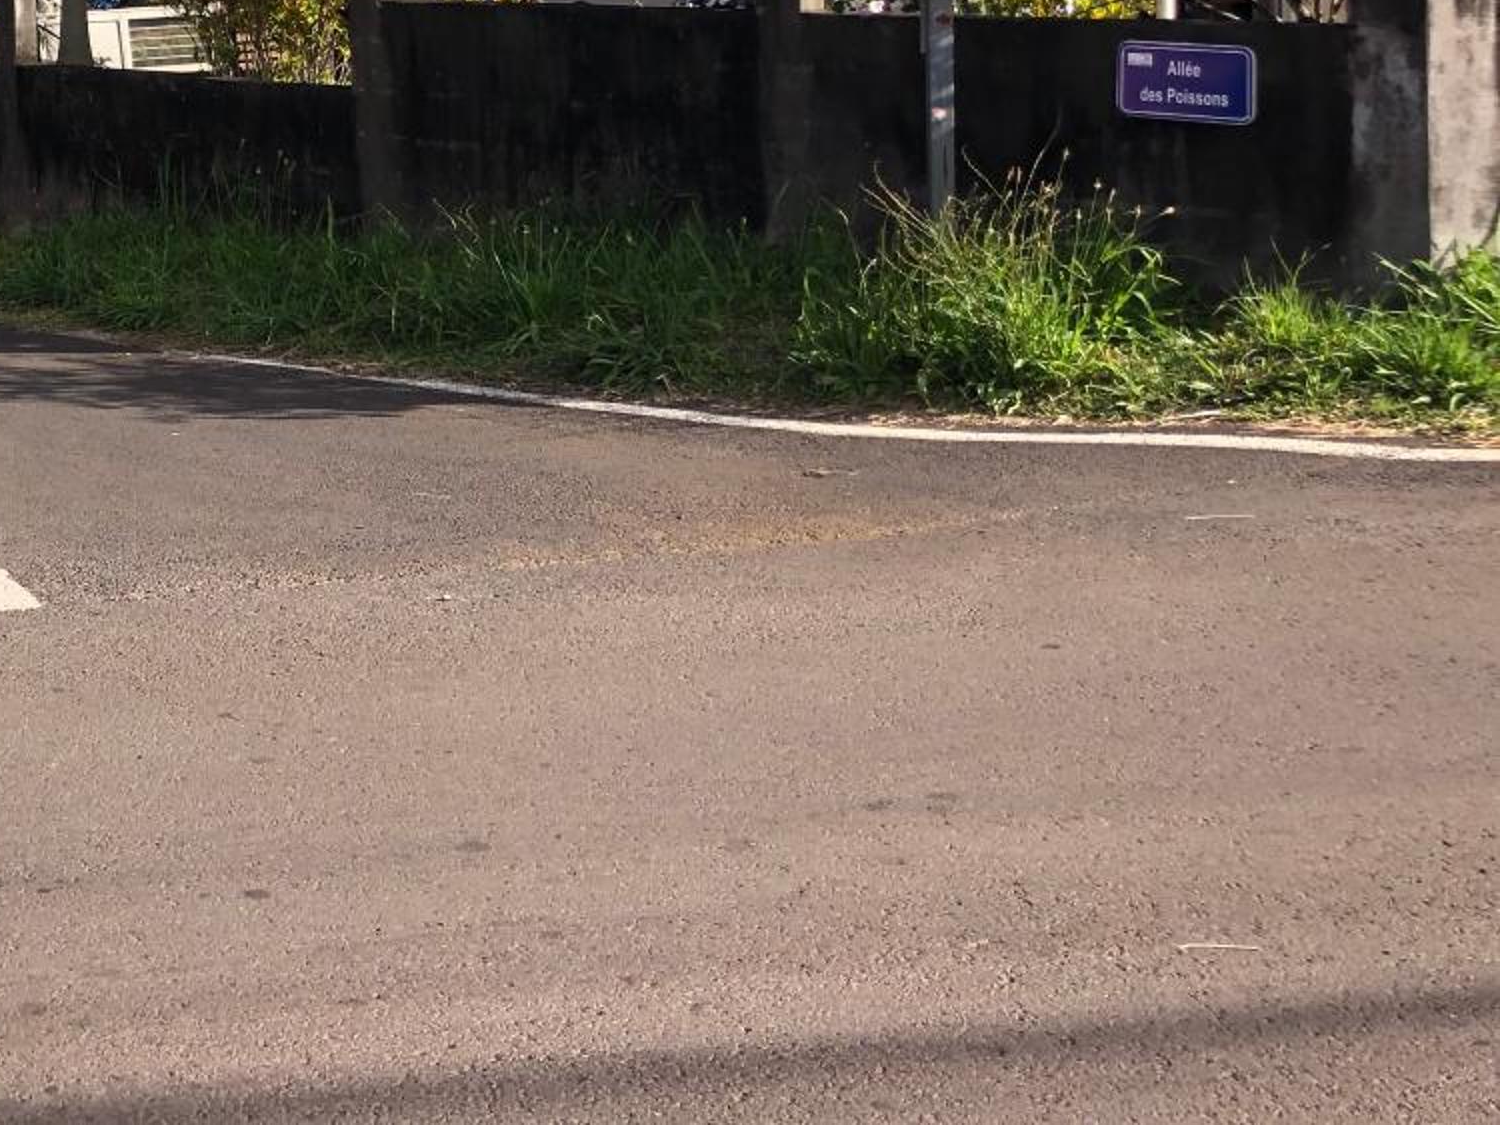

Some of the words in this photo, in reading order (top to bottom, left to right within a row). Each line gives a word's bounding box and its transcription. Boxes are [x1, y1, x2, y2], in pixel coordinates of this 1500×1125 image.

[1167, 60, 1201, 78] Allée
[1139, 86, 1163, 102] des
[1167, 88, 1229, 107] Poissons
